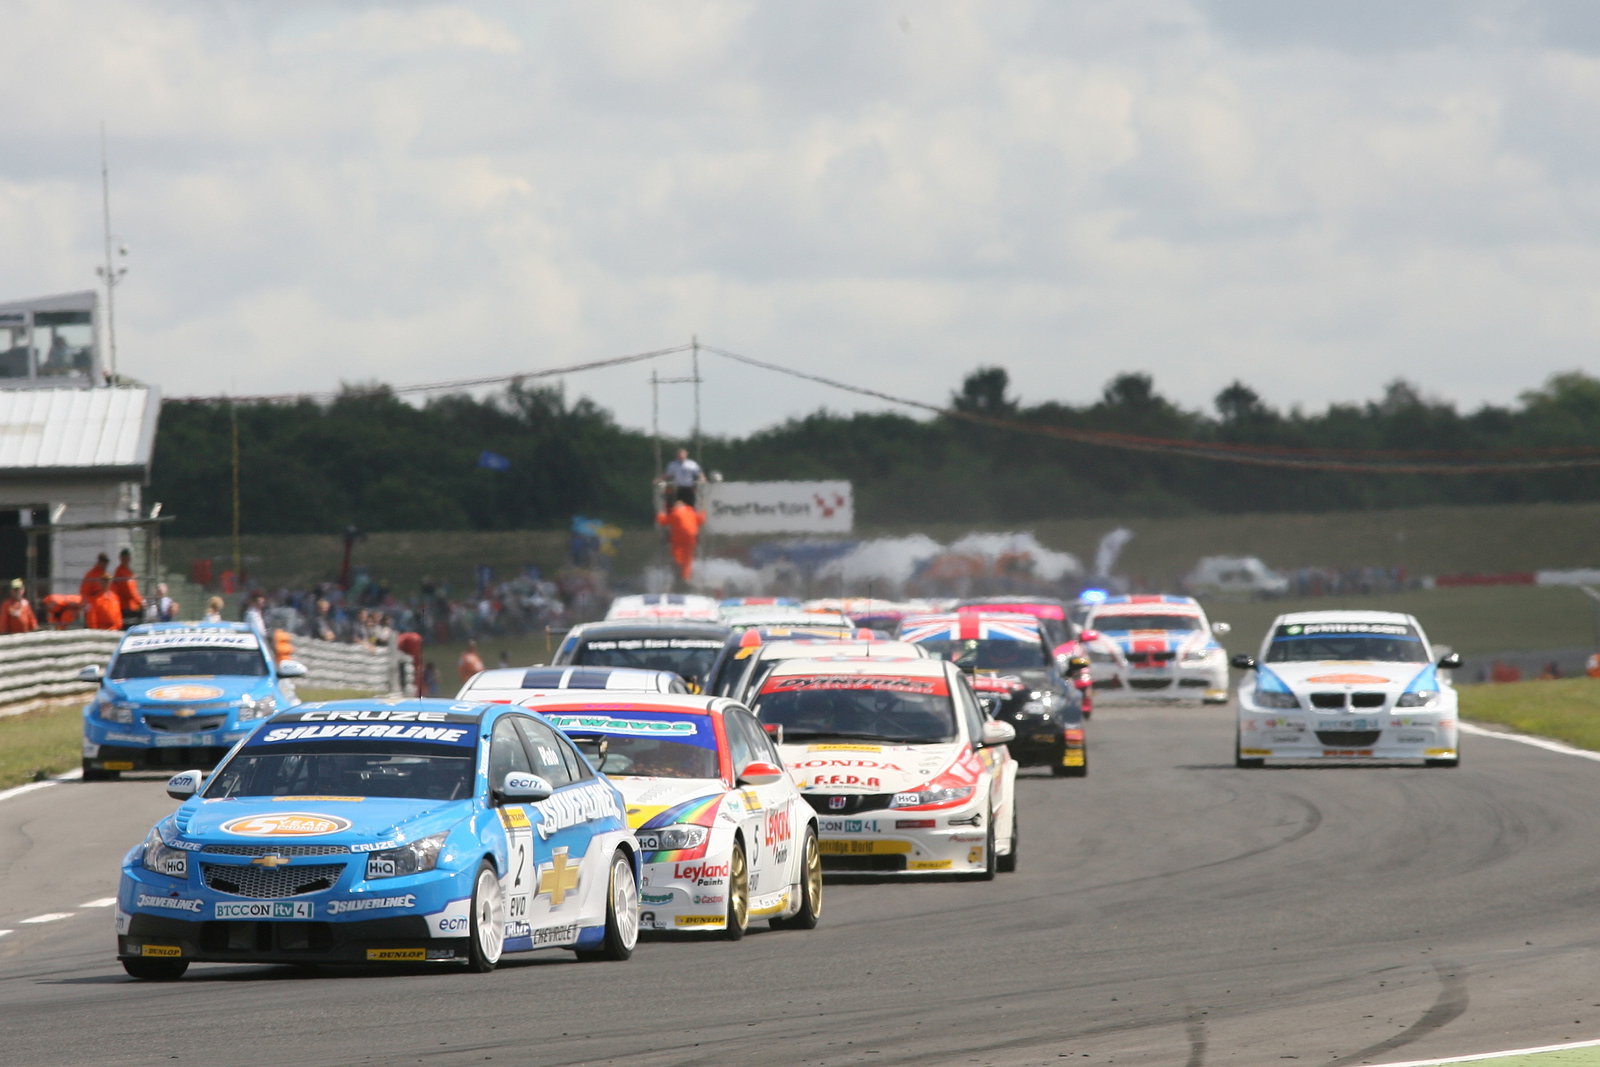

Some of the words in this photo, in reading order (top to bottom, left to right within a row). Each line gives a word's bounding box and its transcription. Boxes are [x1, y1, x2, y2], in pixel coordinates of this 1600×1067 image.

[300, 710, 448, 722] CRUZE
[263, 724, 469, 742] SILVERLINE
[897, 794, 918, 803] HiQ
[168, 838, 202, 851] CRUZE
[351, 840, 398, 853] CRUZE
[167, 859, 186, 872] HiQ
[369, 862, 394, 874] HiQ
[514, 843, 526, 889] 2
[674, 861, 729, 883] Leyland
[697, 877, 724, 887] Paints
[143, 897, 195, 912] SILVERLINE
[274, 903, 294, 916] itv
[337, 895, 406, 913] SILVERLINE
[438, 916, 468, 931] ecm
[533, 923, 578, 945] CHEVROLET
[147, 948, 181, 957] DUNLOP
[378, 950, 424, 959] DUNLOP
